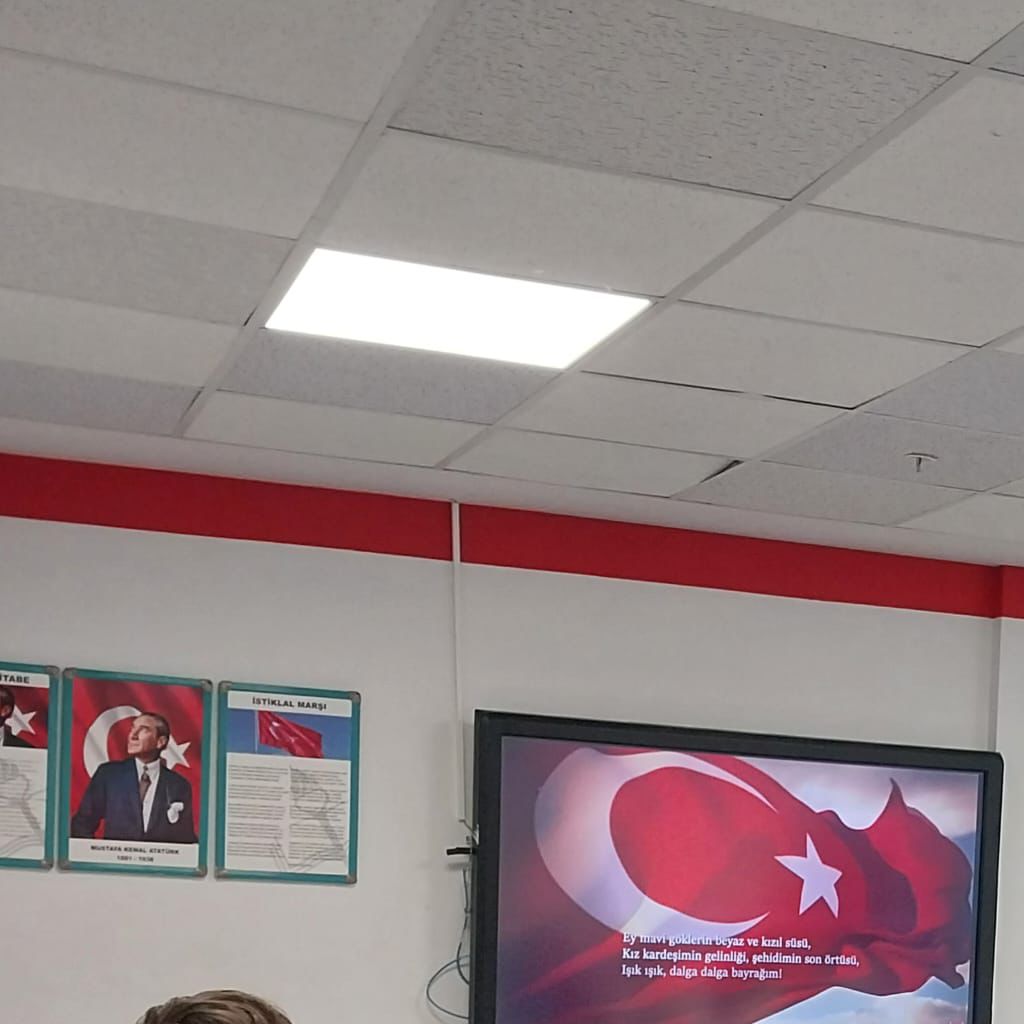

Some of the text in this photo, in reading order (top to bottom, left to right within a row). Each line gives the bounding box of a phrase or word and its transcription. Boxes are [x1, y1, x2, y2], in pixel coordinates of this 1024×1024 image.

[252, 696, 327, 711] İSTİKLAL MARŞI
[715, 936, 745, 947] beyaz
[747, 938, 759, 946] ve
[761, 936, 782, 947] kızıl
[785, 938, 811, 950] süsü,
[622, 948, 860, 967] Kız kardeşimin gelinliği, şehidimin son örtüsü,
[622, 964, 782, 980] Işık ışık, dalga dalga bayrağım!
